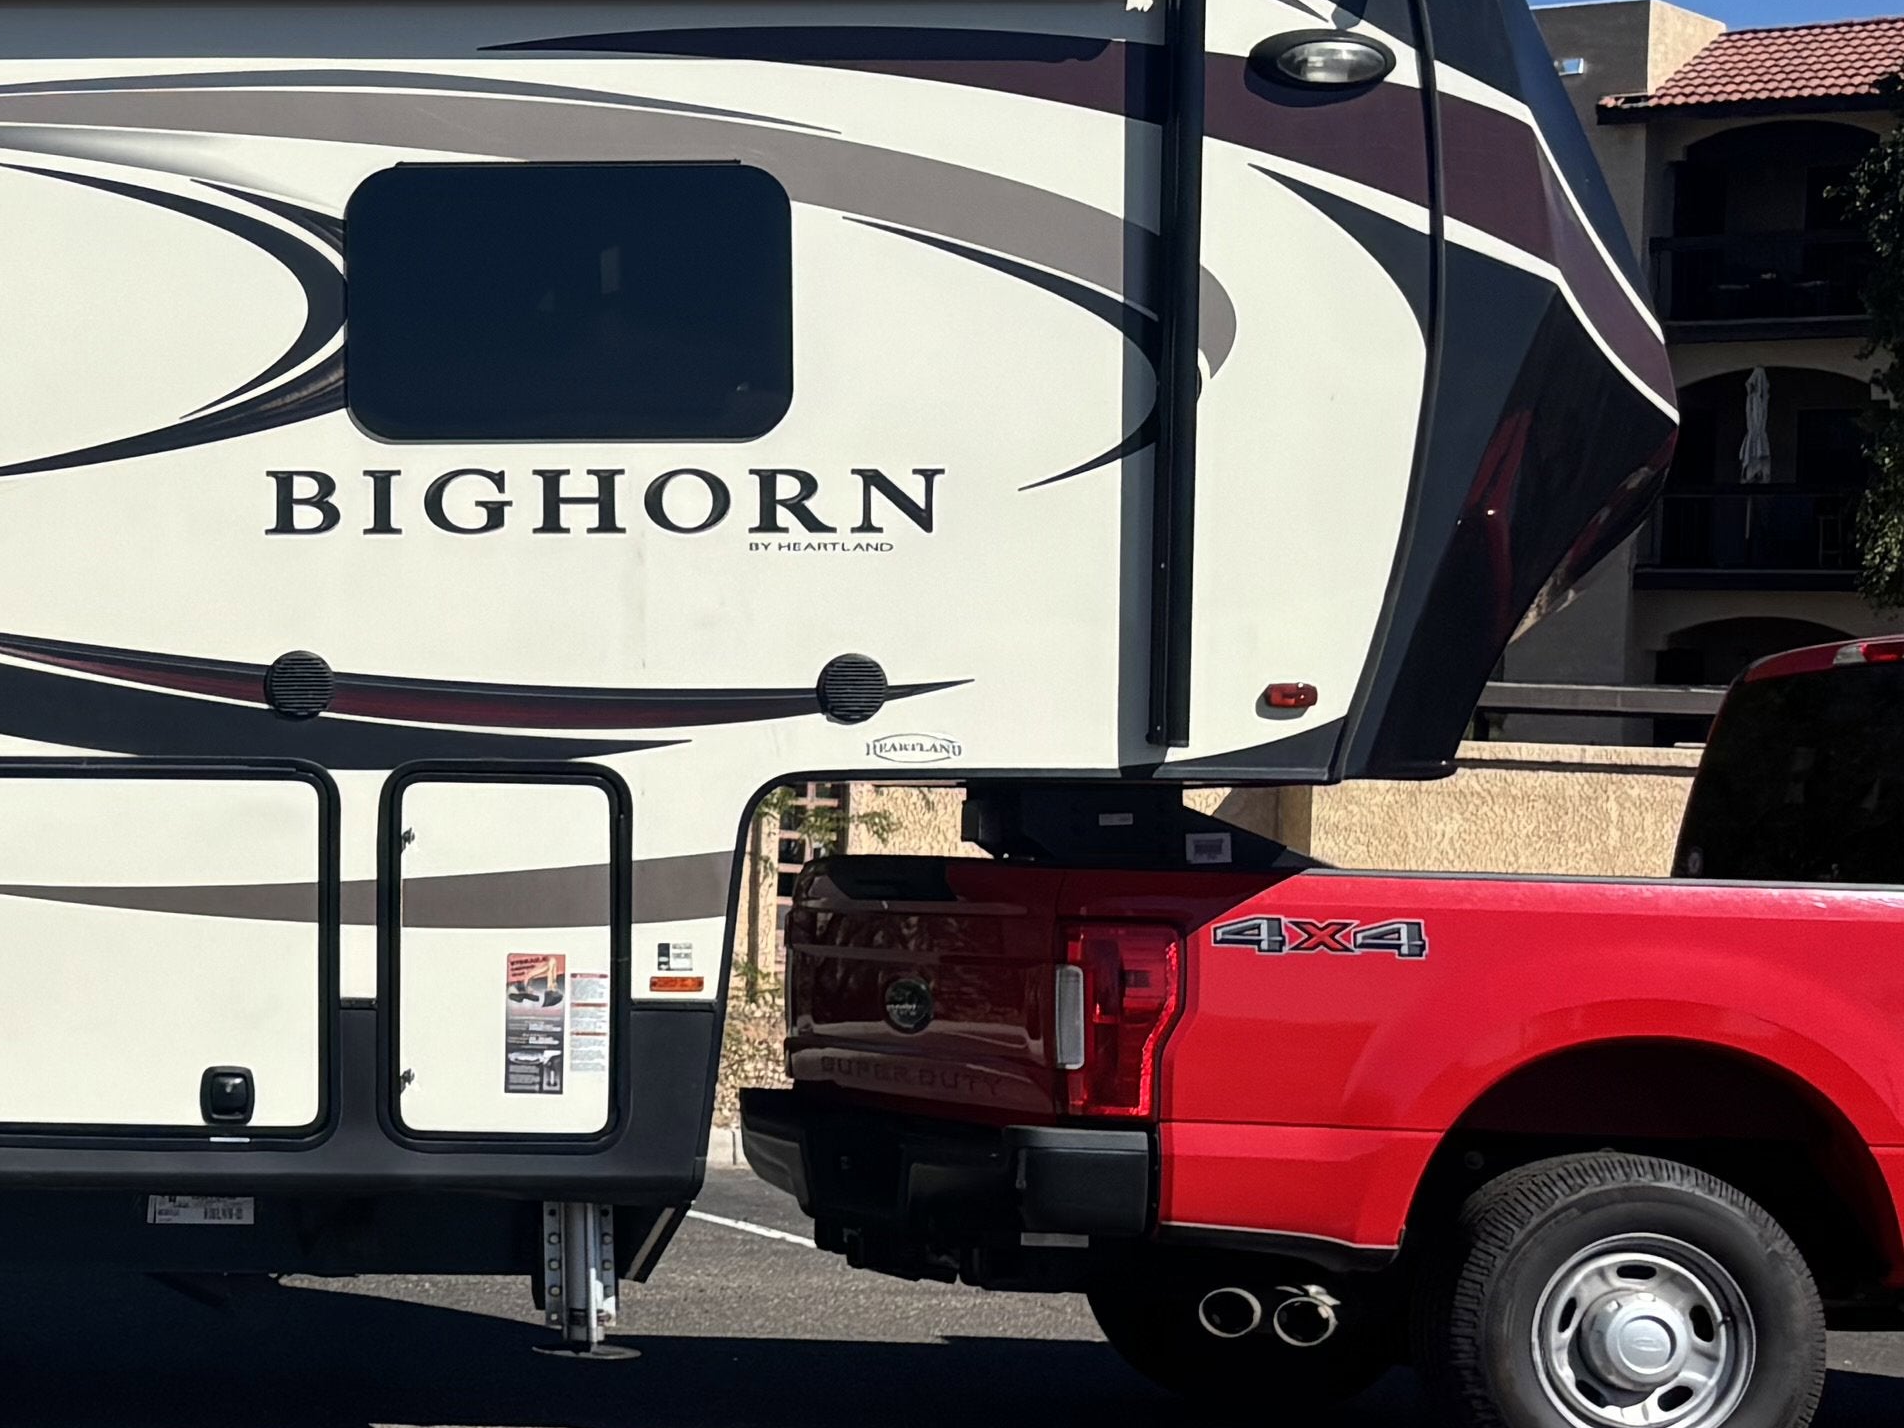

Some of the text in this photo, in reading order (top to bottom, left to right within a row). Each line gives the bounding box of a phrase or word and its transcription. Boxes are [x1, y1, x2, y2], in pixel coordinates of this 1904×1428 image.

[265, 467, 946, 535] BIGHORN
[748, 541, 894, 552] BY HEARTLAND
